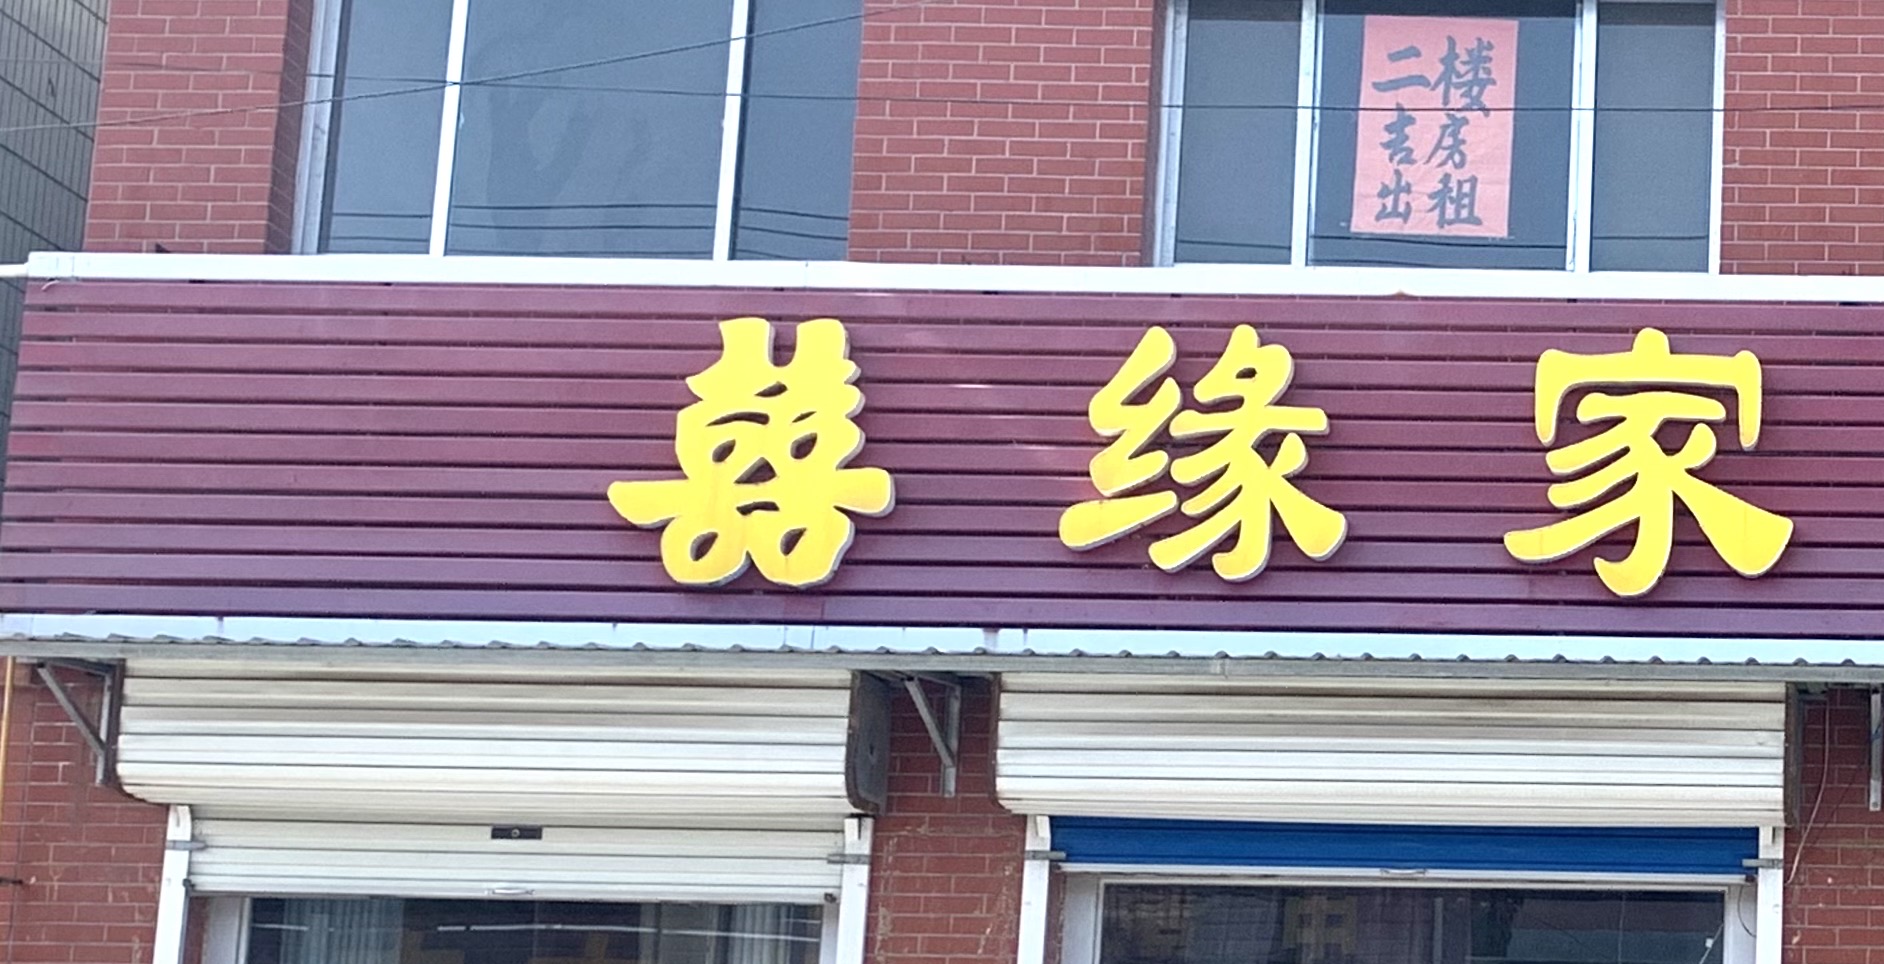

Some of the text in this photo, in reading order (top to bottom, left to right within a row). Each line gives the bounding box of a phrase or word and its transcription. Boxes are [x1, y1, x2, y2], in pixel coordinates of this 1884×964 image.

[1372, 35, 1497, 118] 二楼
[1380, 102, 1470, 170] 吉房
[1374, 169, 1482, 229] 出租
